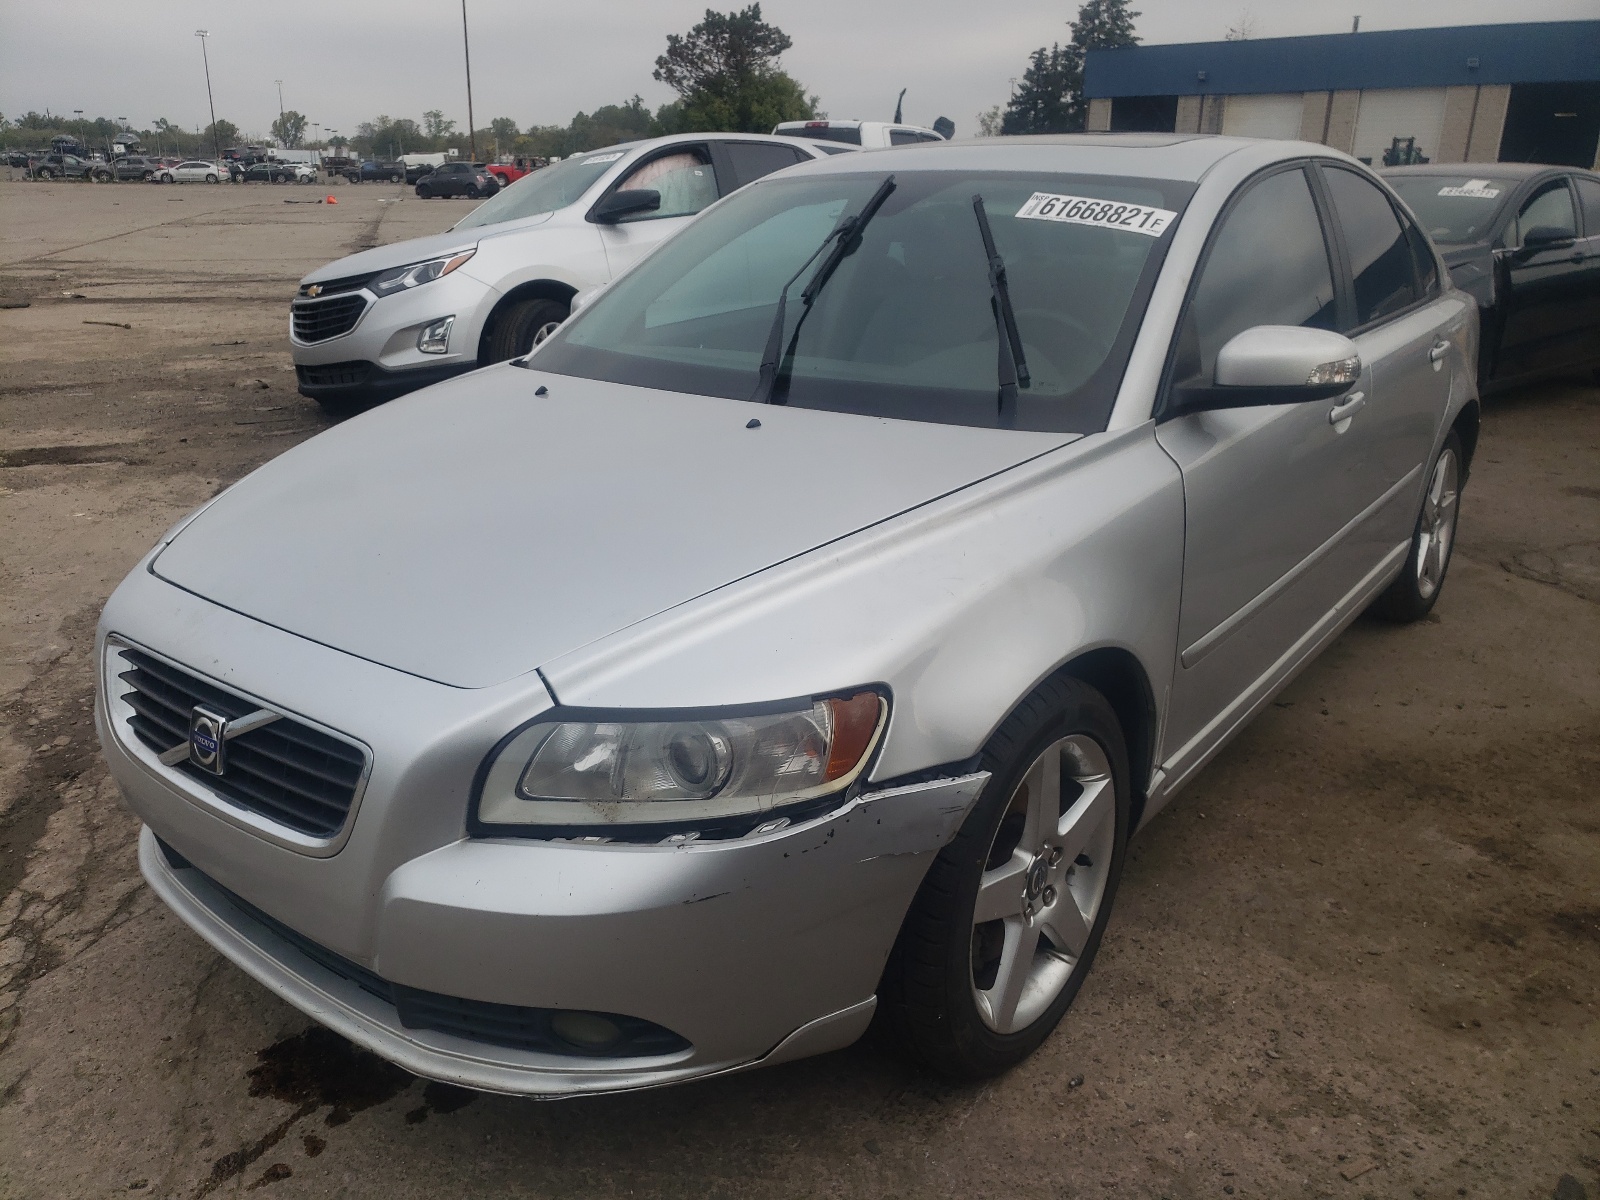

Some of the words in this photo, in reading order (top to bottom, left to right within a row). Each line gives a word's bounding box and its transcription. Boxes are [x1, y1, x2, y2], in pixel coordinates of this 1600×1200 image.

[1031, 194, 1050, 202] INSP
[1039, 197, 1155, 229] 61668821
[1151, 218, 1164, 229] F
[195, 735, 214, 749] VOLVO
